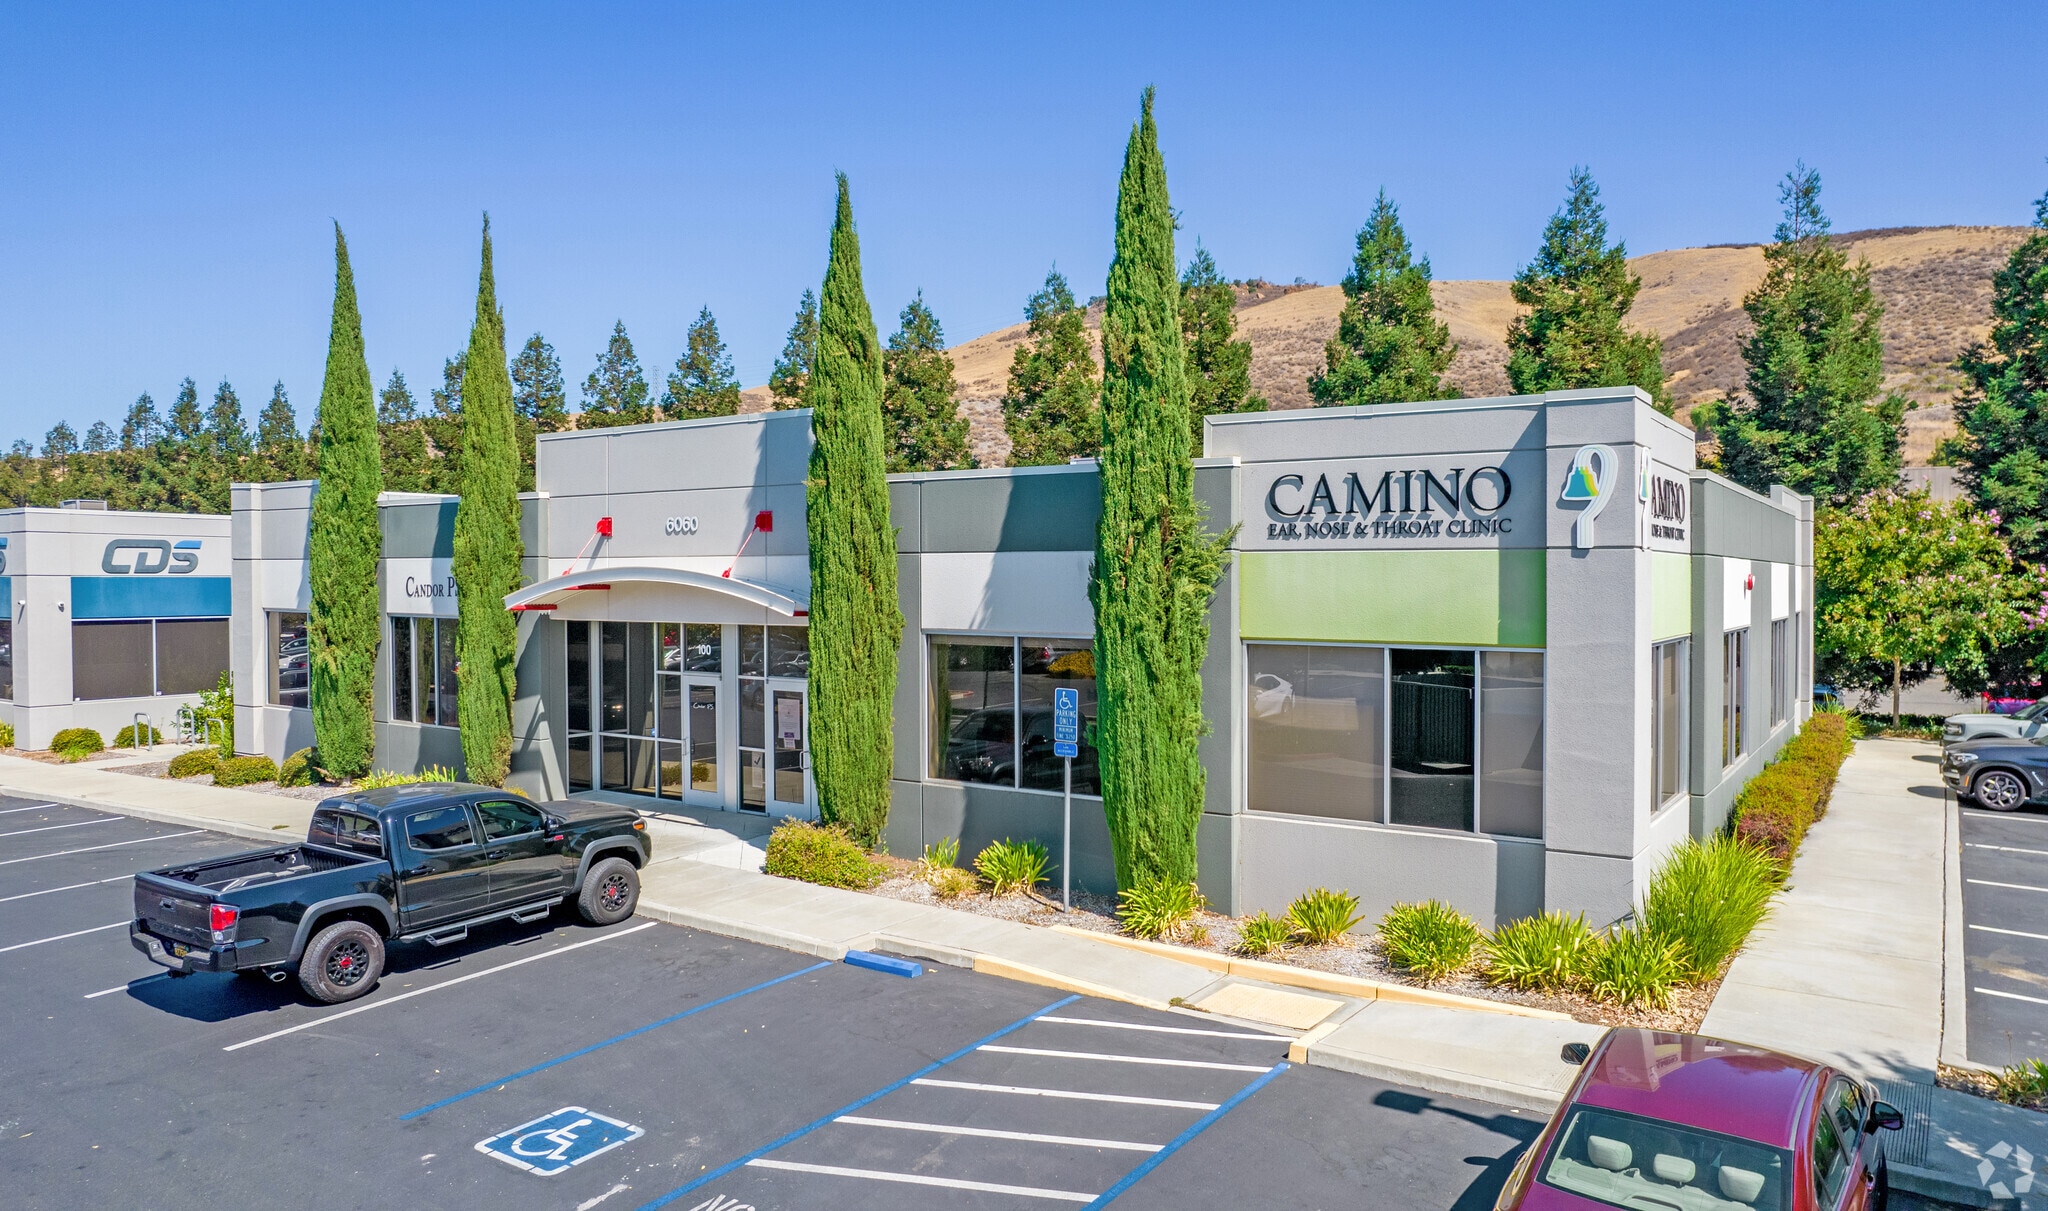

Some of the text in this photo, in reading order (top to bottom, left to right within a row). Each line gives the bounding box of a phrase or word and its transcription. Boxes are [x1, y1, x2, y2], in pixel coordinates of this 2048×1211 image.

[1268, 466, 1512, 516] CAMINO
[1651, 474, 1686, 524] AMINO
[666, 516, 699, 533] 6060
[1268, 518, 1512, 538] EAR, NOSE & THROAT CLINIC
[101, 539, 203, 574] CDS
[698, 644, 712, 656] 100
[1056, 709, 1076, 719] PARKING
[1059, 716, 1072, 725] ONLY
